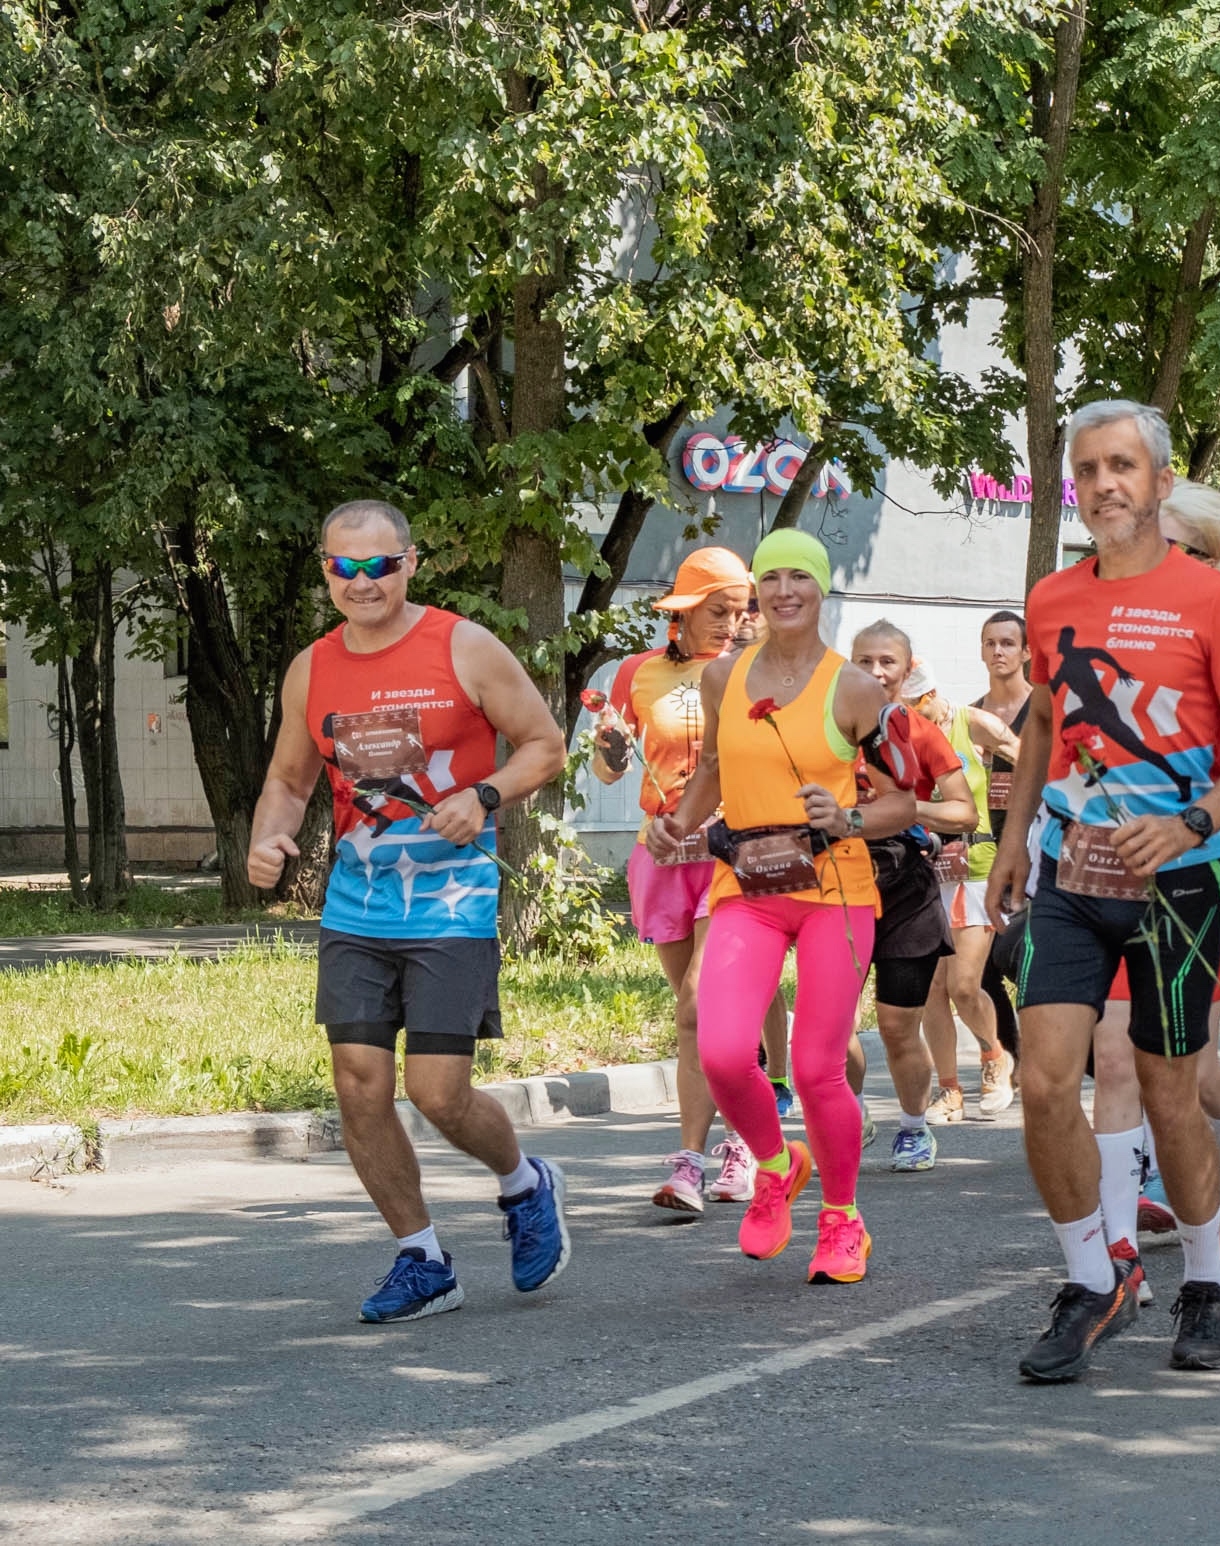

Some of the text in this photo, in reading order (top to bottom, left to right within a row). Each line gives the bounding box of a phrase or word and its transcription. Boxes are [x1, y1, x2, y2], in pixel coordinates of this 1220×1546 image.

[1111, 605, 1182, 623] И звезды
[1107, 622, 1195, 640] становятся
[1106, 637, 1156, 651] ближе
[371, 688, 435, 700] И звезды
